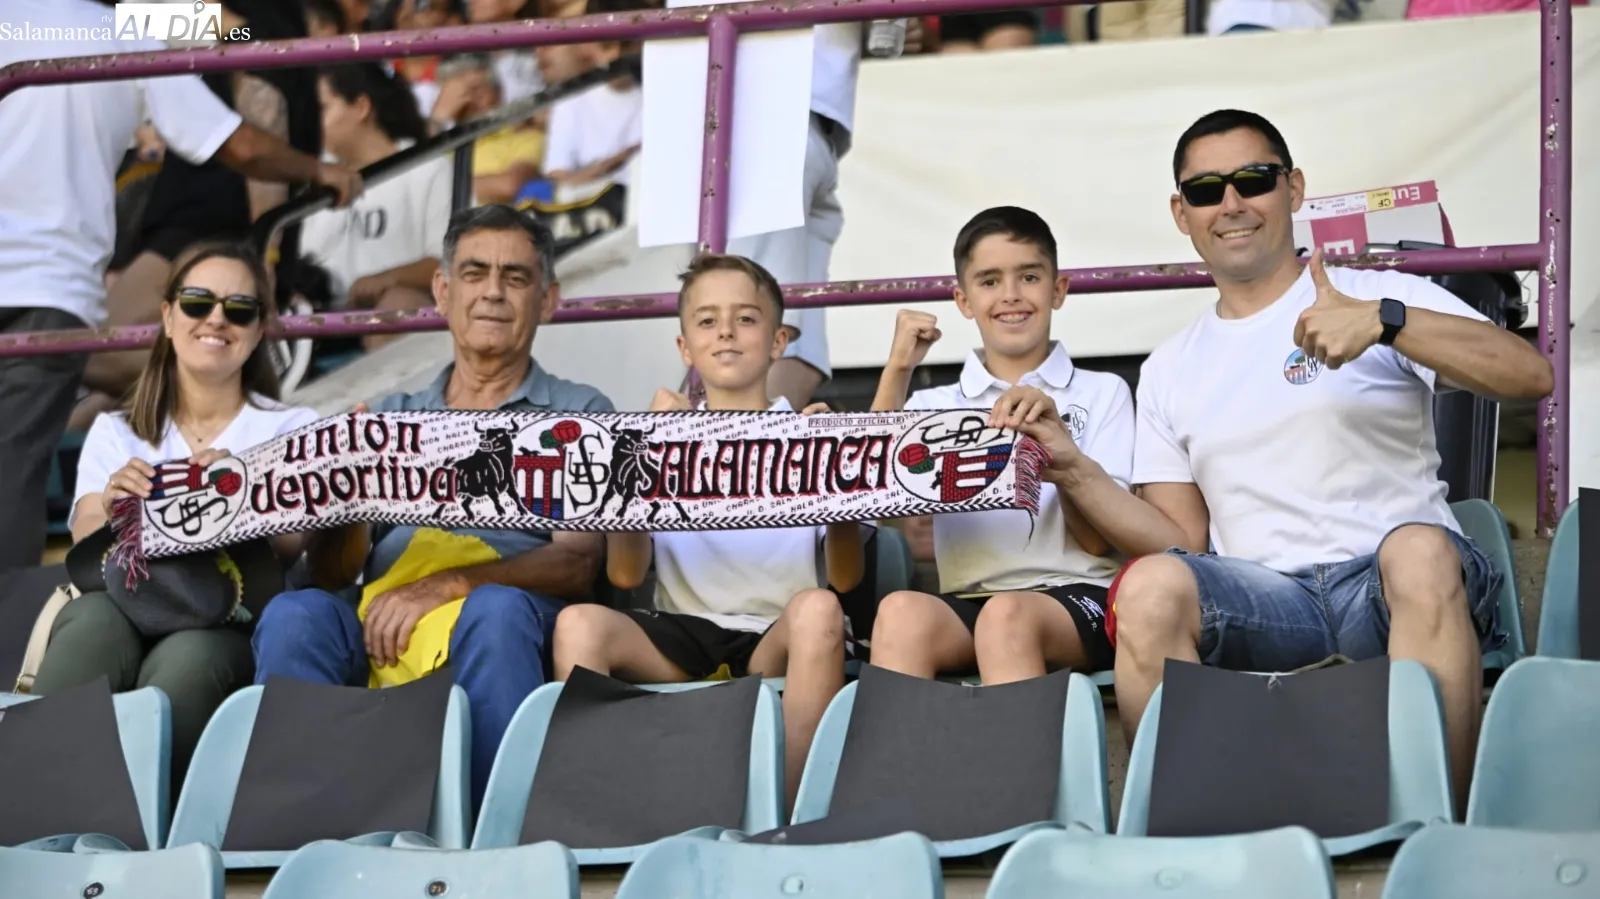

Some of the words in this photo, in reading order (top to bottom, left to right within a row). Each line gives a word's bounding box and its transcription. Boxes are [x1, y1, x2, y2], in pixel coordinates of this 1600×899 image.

[1377, 198, 1391, 208] CF
[284, 412, 422, 463] unión
[810, 418, 853, 427] PRODUCTO
[858, 418, 893, 426] OFICIAL
[251, 455, 456, 517] deportiva
[637, 434, 894, 501] SALAMANCA
